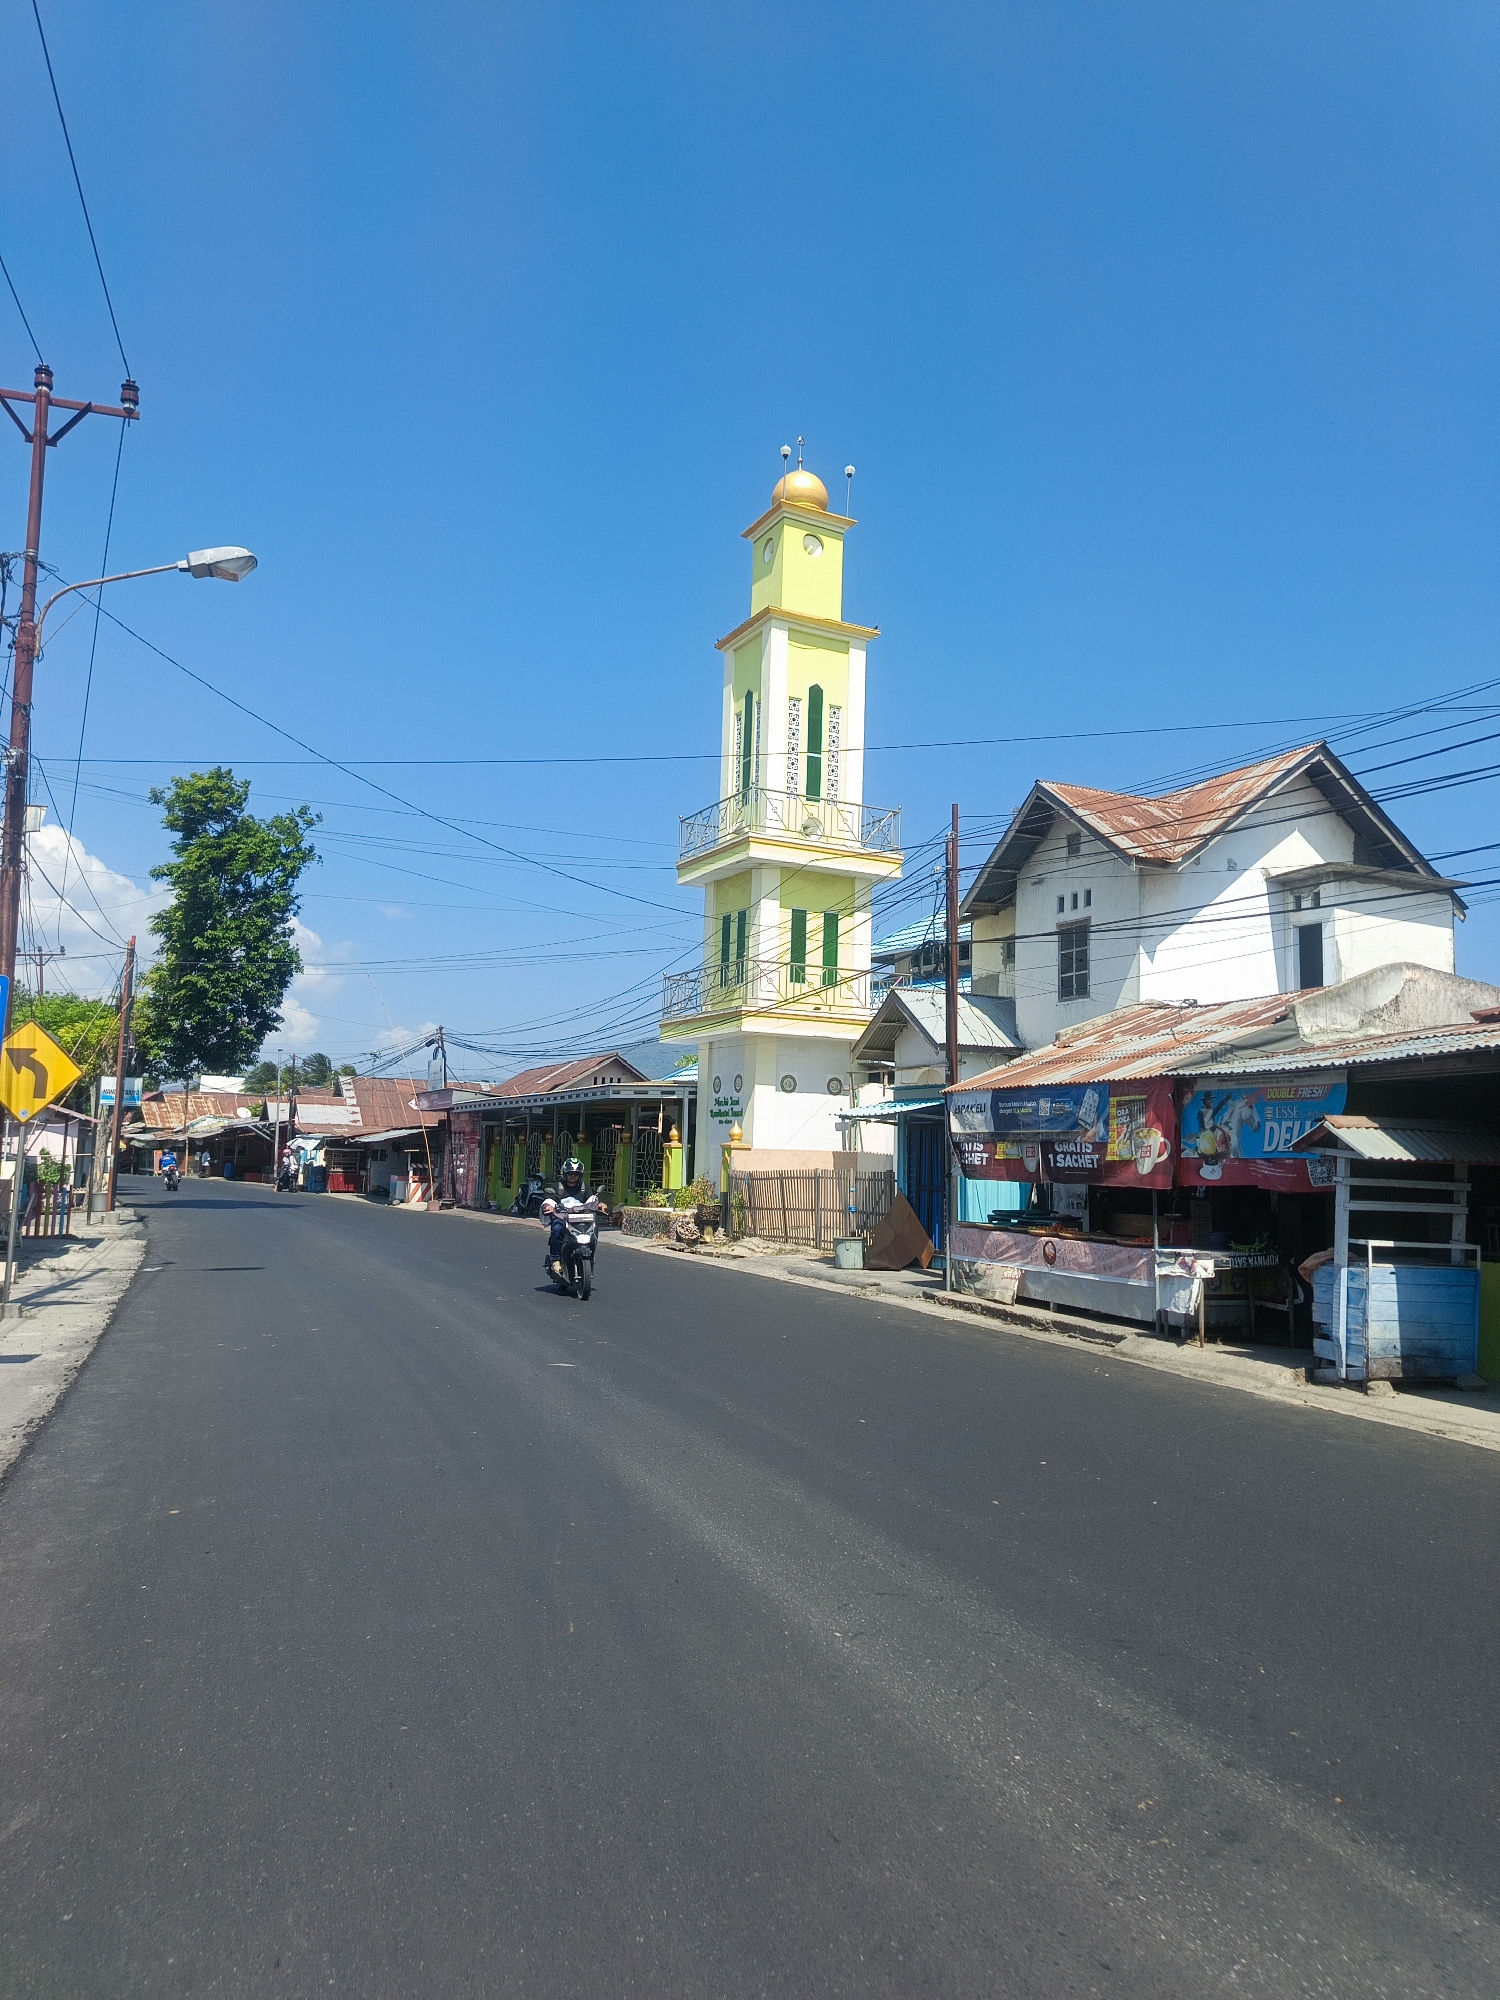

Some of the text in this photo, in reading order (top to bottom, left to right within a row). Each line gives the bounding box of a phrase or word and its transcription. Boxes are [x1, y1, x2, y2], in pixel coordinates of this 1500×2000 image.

[1267, 1086, 1327, 1099] DOUBLE FRESH!
[1275, 1106, 1300, 1119] ESSE
[1054, 1142, 1092, 1152] GRATIS
[1048, 1154, 1098, 1168] 1 SACHET
[1230, 1255, 1279, 1268] KOPINYA SATU
